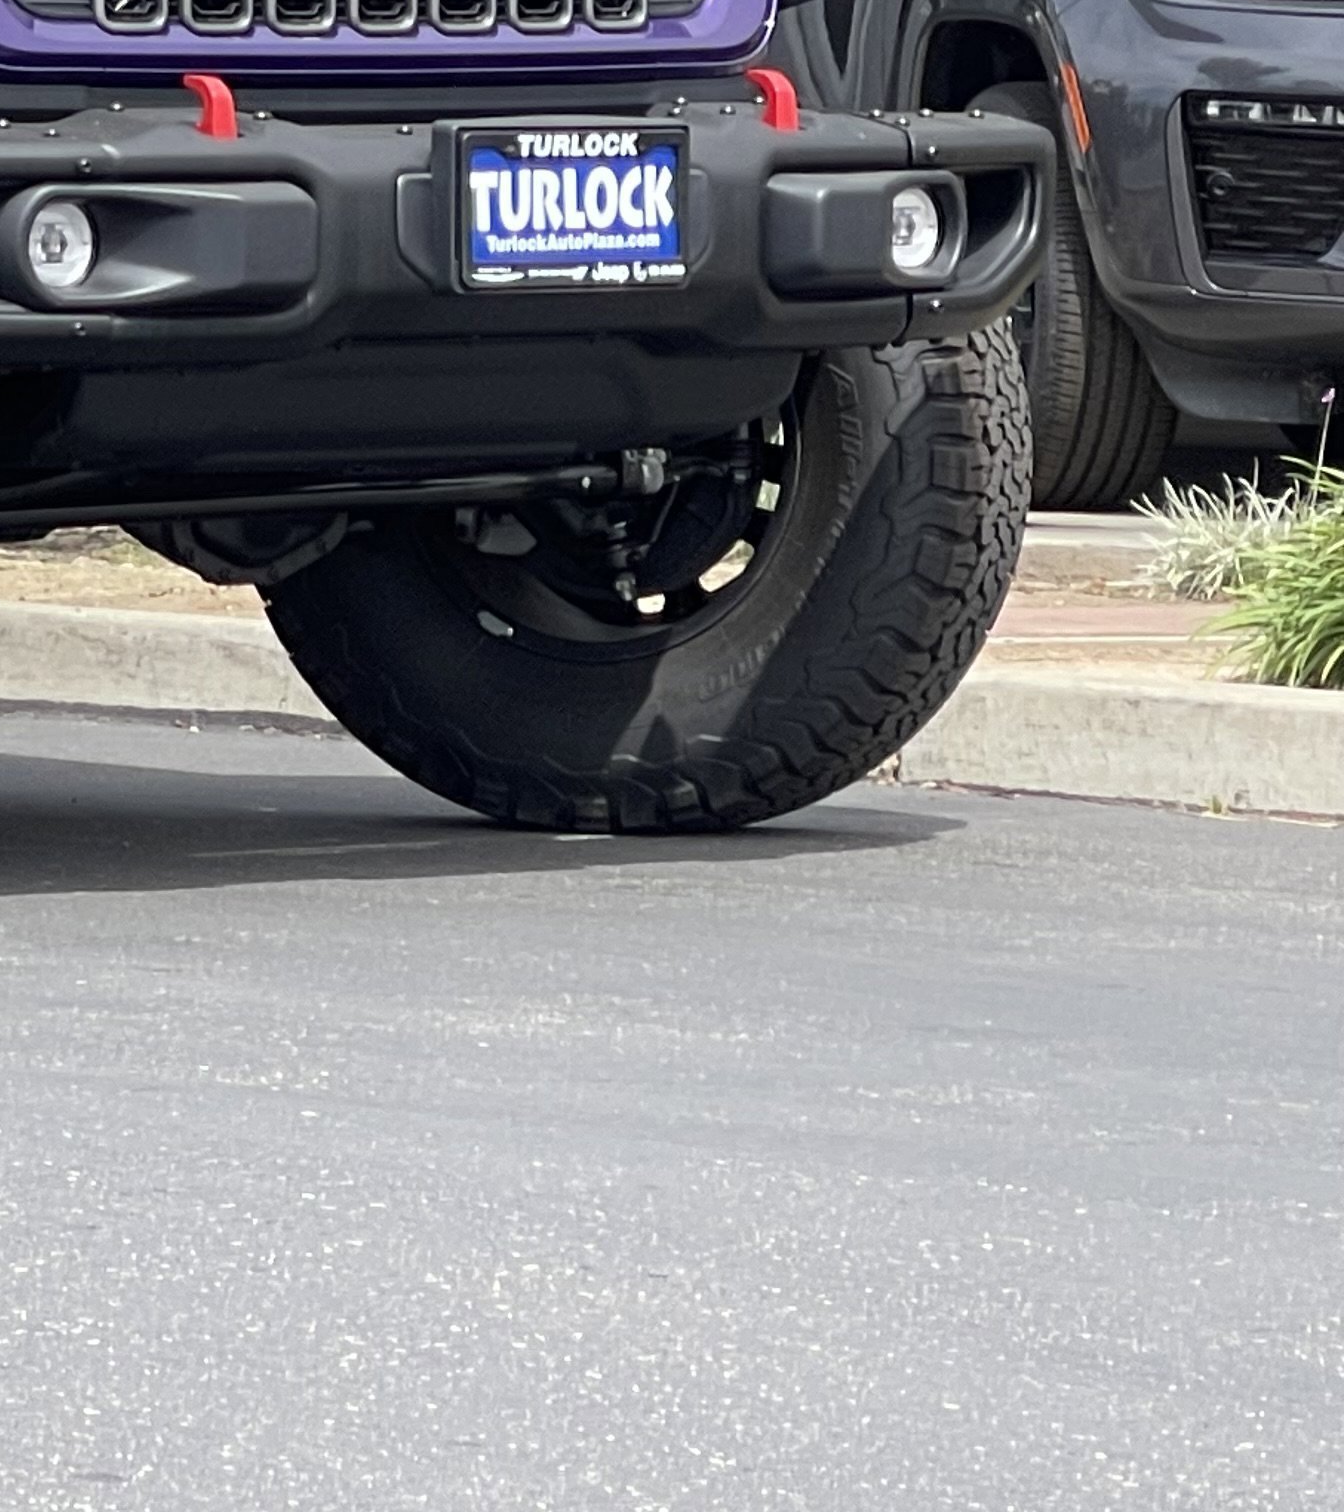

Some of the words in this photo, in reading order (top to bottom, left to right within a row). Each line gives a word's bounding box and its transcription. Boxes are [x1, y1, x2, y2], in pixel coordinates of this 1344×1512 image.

[517, 132, 639, 157] TURLOCK
[469, 164, 675, 232] TURLOCK
[485, 232, 660, 253] TurlockAutoPlaza.com
